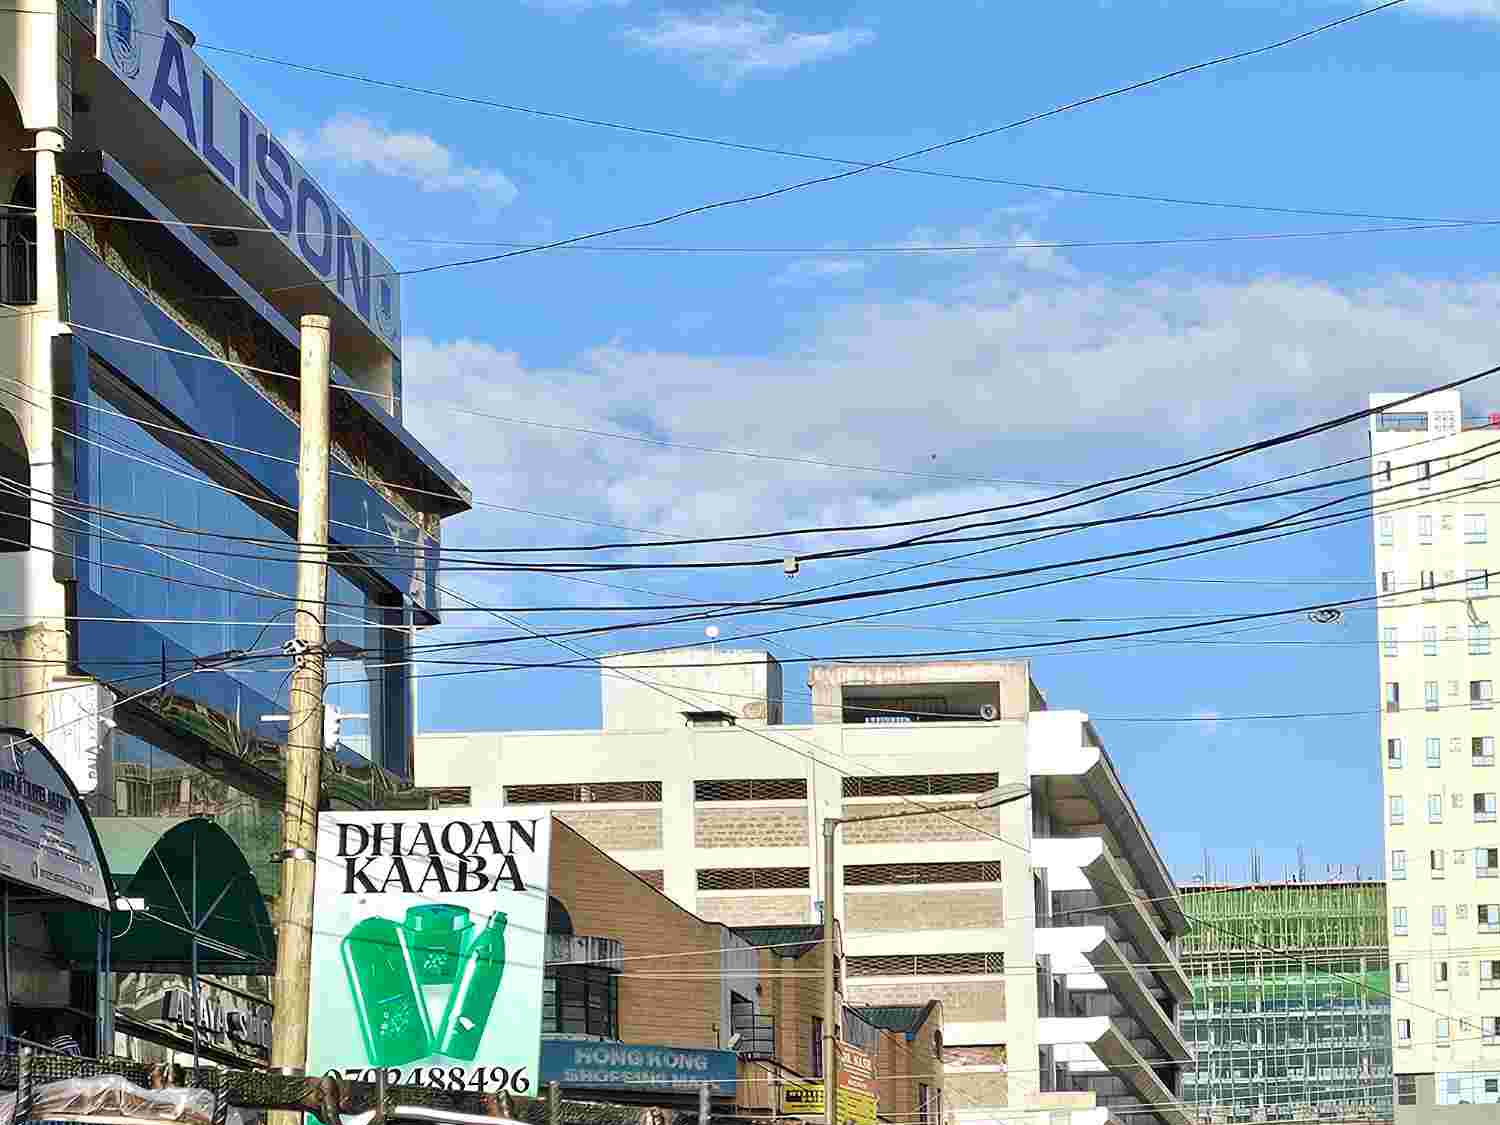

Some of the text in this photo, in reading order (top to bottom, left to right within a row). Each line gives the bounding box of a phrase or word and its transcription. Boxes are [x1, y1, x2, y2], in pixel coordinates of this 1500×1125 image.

[150, 31, 369, 322] ALISON
[336, 820, 537, 862] DHAQAN
[343, 855, 528, 894] KAABA
